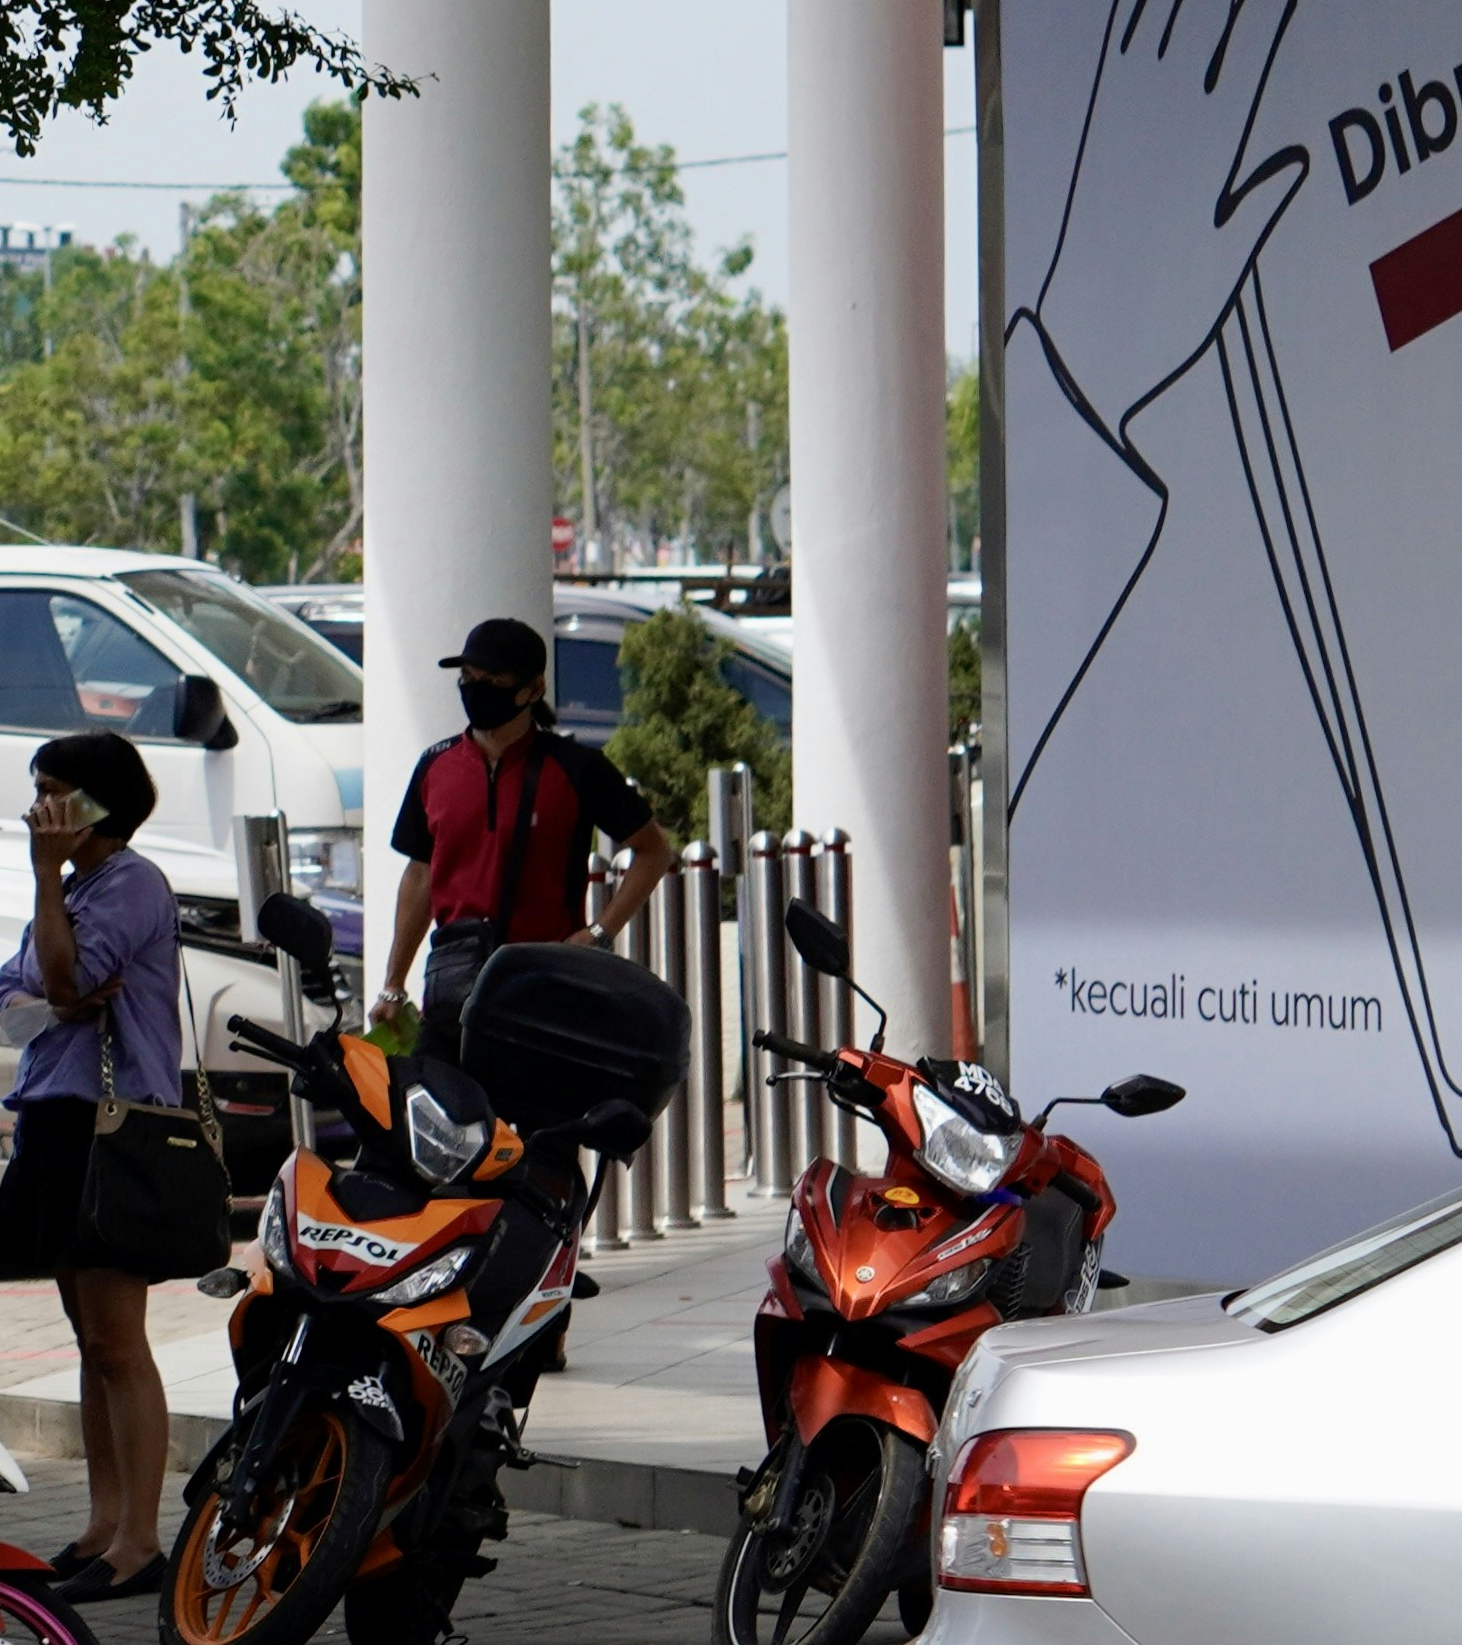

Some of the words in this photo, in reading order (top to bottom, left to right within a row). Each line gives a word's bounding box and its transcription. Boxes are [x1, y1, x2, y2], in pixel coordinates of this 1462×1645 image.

[1328, 67, 1462, 206] Dib
[1198, 979, 1257, 1024] cuti
[1271, 990, 1382, 1032] umum
[299, 1223, 399, 1262] REPSOL
